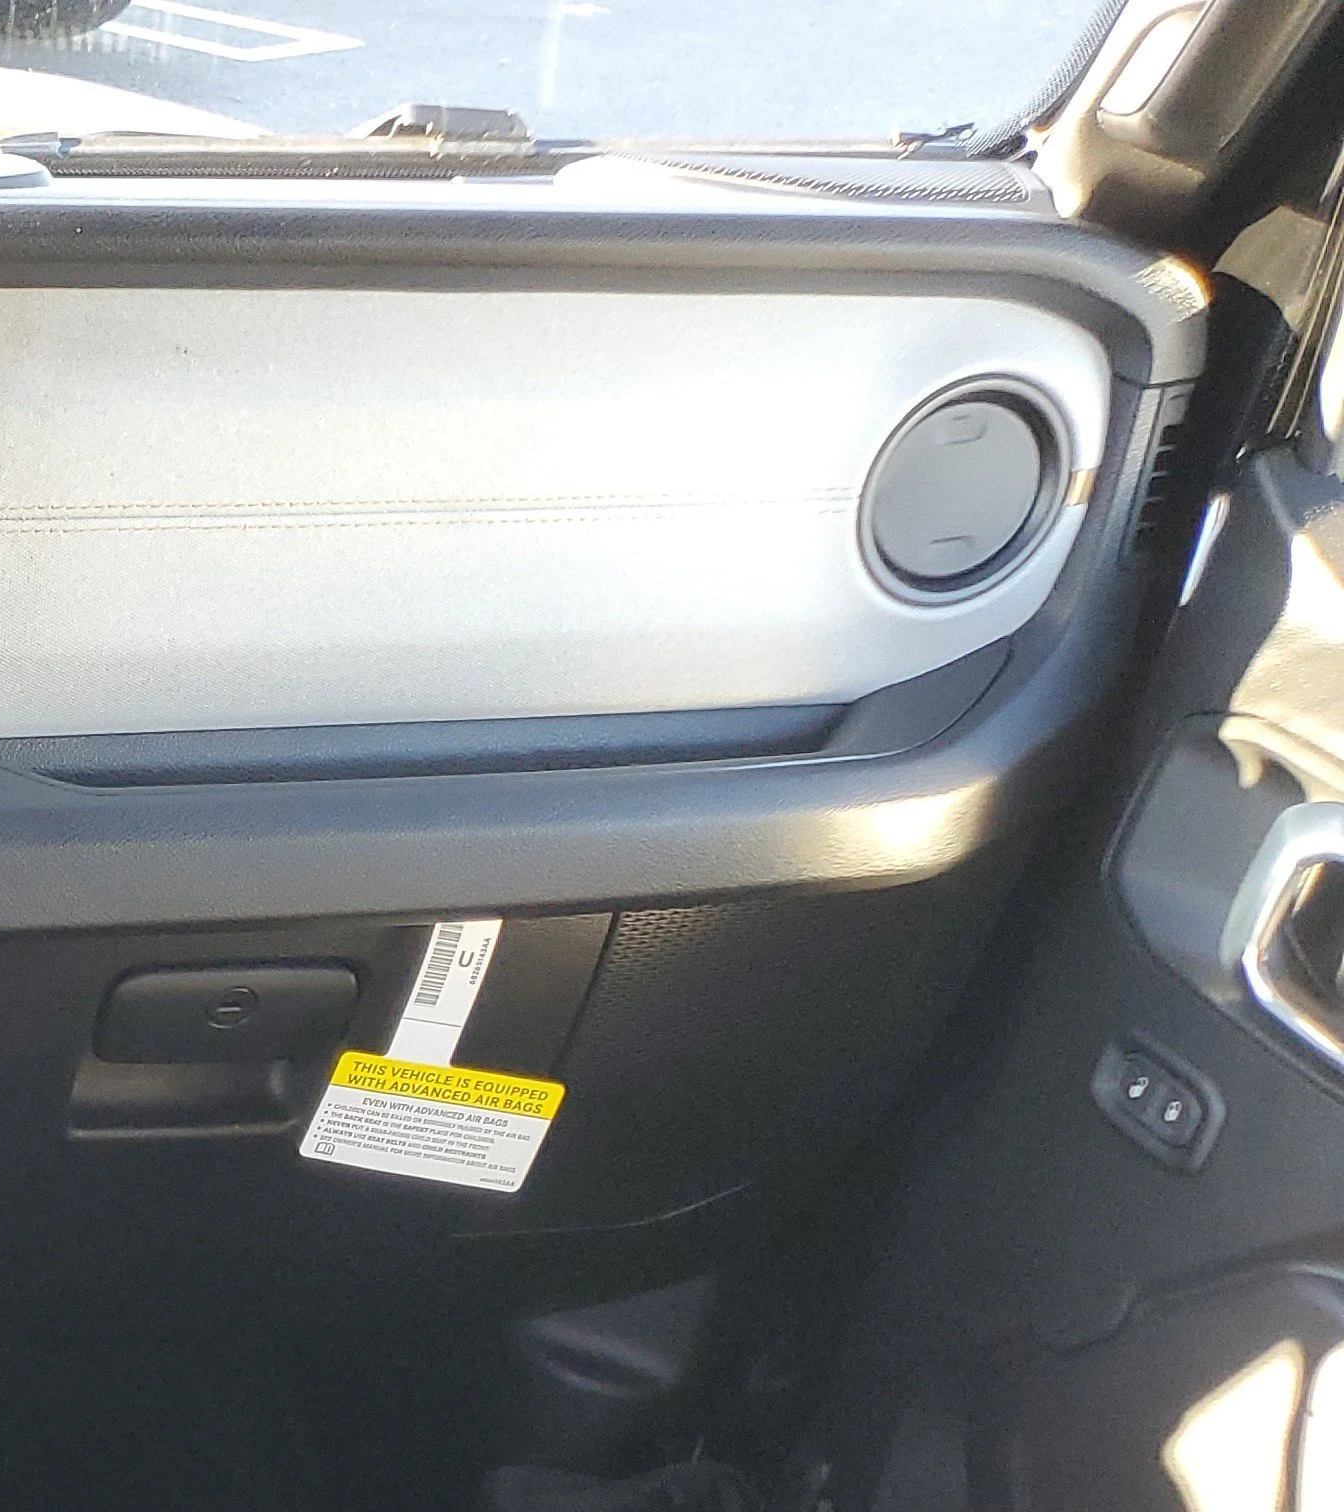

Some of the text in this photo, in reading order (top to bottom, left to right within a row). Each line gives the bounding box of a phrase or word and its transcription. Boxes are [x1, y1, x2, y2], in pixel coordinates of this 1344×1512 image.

[348, 1074, 543, 1114] WITH ADVANCED AIR BAGS
[353, 1061, 548, 1100] THIS VEHICLE IS EQUIPPED
[362, 1097, 387, 1109] EVEN
[390, 1101, 413, 1112] WITH
[414, 1106, 464, 1120] ADVANCED
[466, 1114, 481, 1123] AIR
[483, 1117, 508, 1127] BAGS
[322, 1127, 353, 1137] ALWAYS
